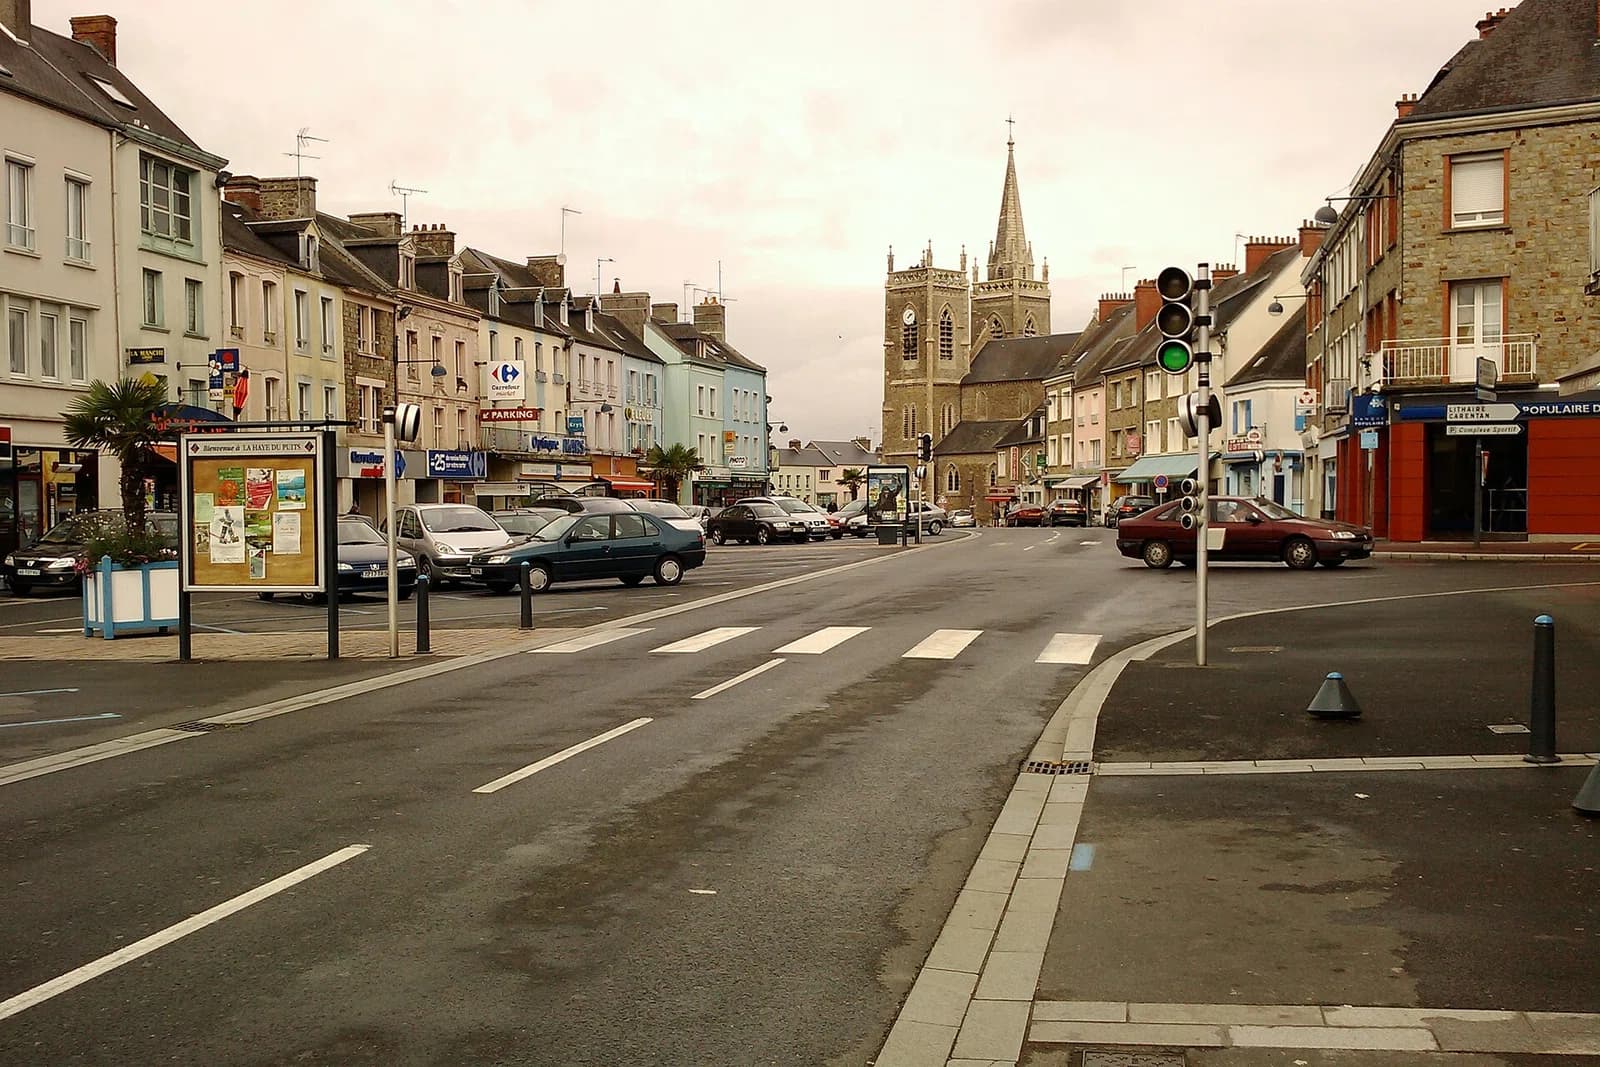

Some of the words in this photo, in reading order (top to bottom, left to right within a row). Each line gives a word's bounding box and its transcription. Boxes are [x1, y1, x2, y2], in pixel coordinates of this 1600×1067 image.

[1523, 405, 1590, 414] POPULAIRE
[492, 411, 533, 419] PARKING
[282, 443, 301, 451] PUITS
